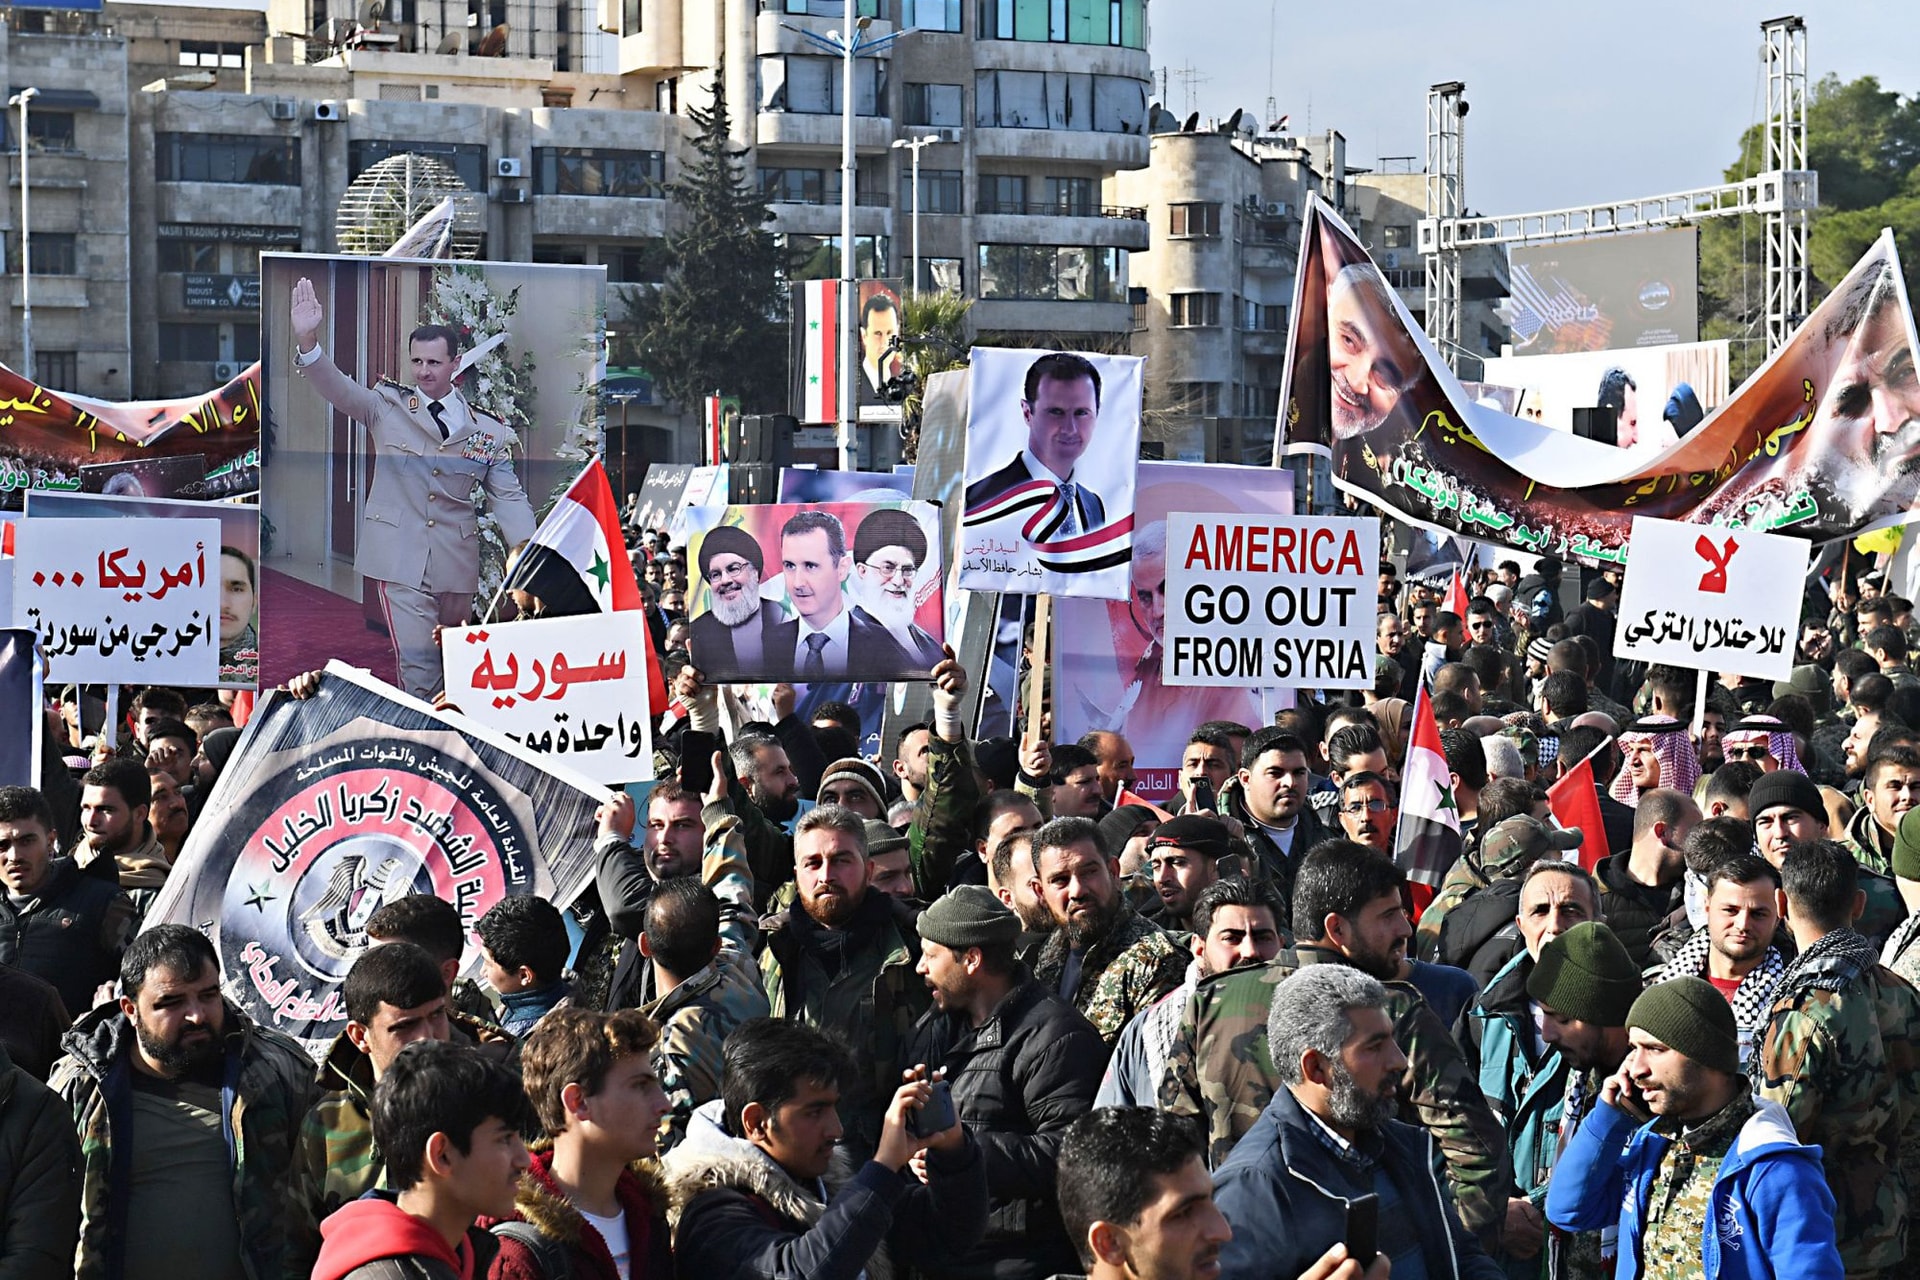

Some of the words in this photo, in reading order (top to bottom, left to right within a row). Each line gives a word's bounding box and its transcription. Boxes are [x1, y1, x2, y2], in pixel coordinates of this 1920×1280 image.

[185, 226, 220, 238] TRADING
[962, 557, 993, 573] الأسد
[992, 559, 1017, 573] حافظ
[994, 540, 1019, 555] السيد
[1184, 524, 1364, 576] AMERICA
[1694, 534, 1740, 594] لا
[97, 541, 206, 603] أمريكا
[1017, 560, 1043, 579] بشار
[1184, 584, 1250, 625] GO
[1264, 585, 1357, 627] OUT
[99, 615, 130, 658] من
[130, 610, 212, 662] اخرجي
[1624, 609, 1695, 648] التركي
[1692, 617, 1786, 655] للاحتلال
[465, 629, 626, 710] سورية
[1173, 636, 1263, 677] FROM
[1272, 637, 1368, 680] SYRIA
[360, 745, 417, 767] والقوات
[553, 711, 642, 758] واحدة
[295, 747, 355, 782] المسلحة
[418, 755, 474, 791] للجيش
[1134, 773, 1172, 795] العالم
[338, 778, 400, 823] زكريا
[470, 788, 511, 834] العامة
[263, 792, 333, 874] الخليل
[402, 798, 488, 877] الشهيد
[501, 835, 527, 886] القيادة
